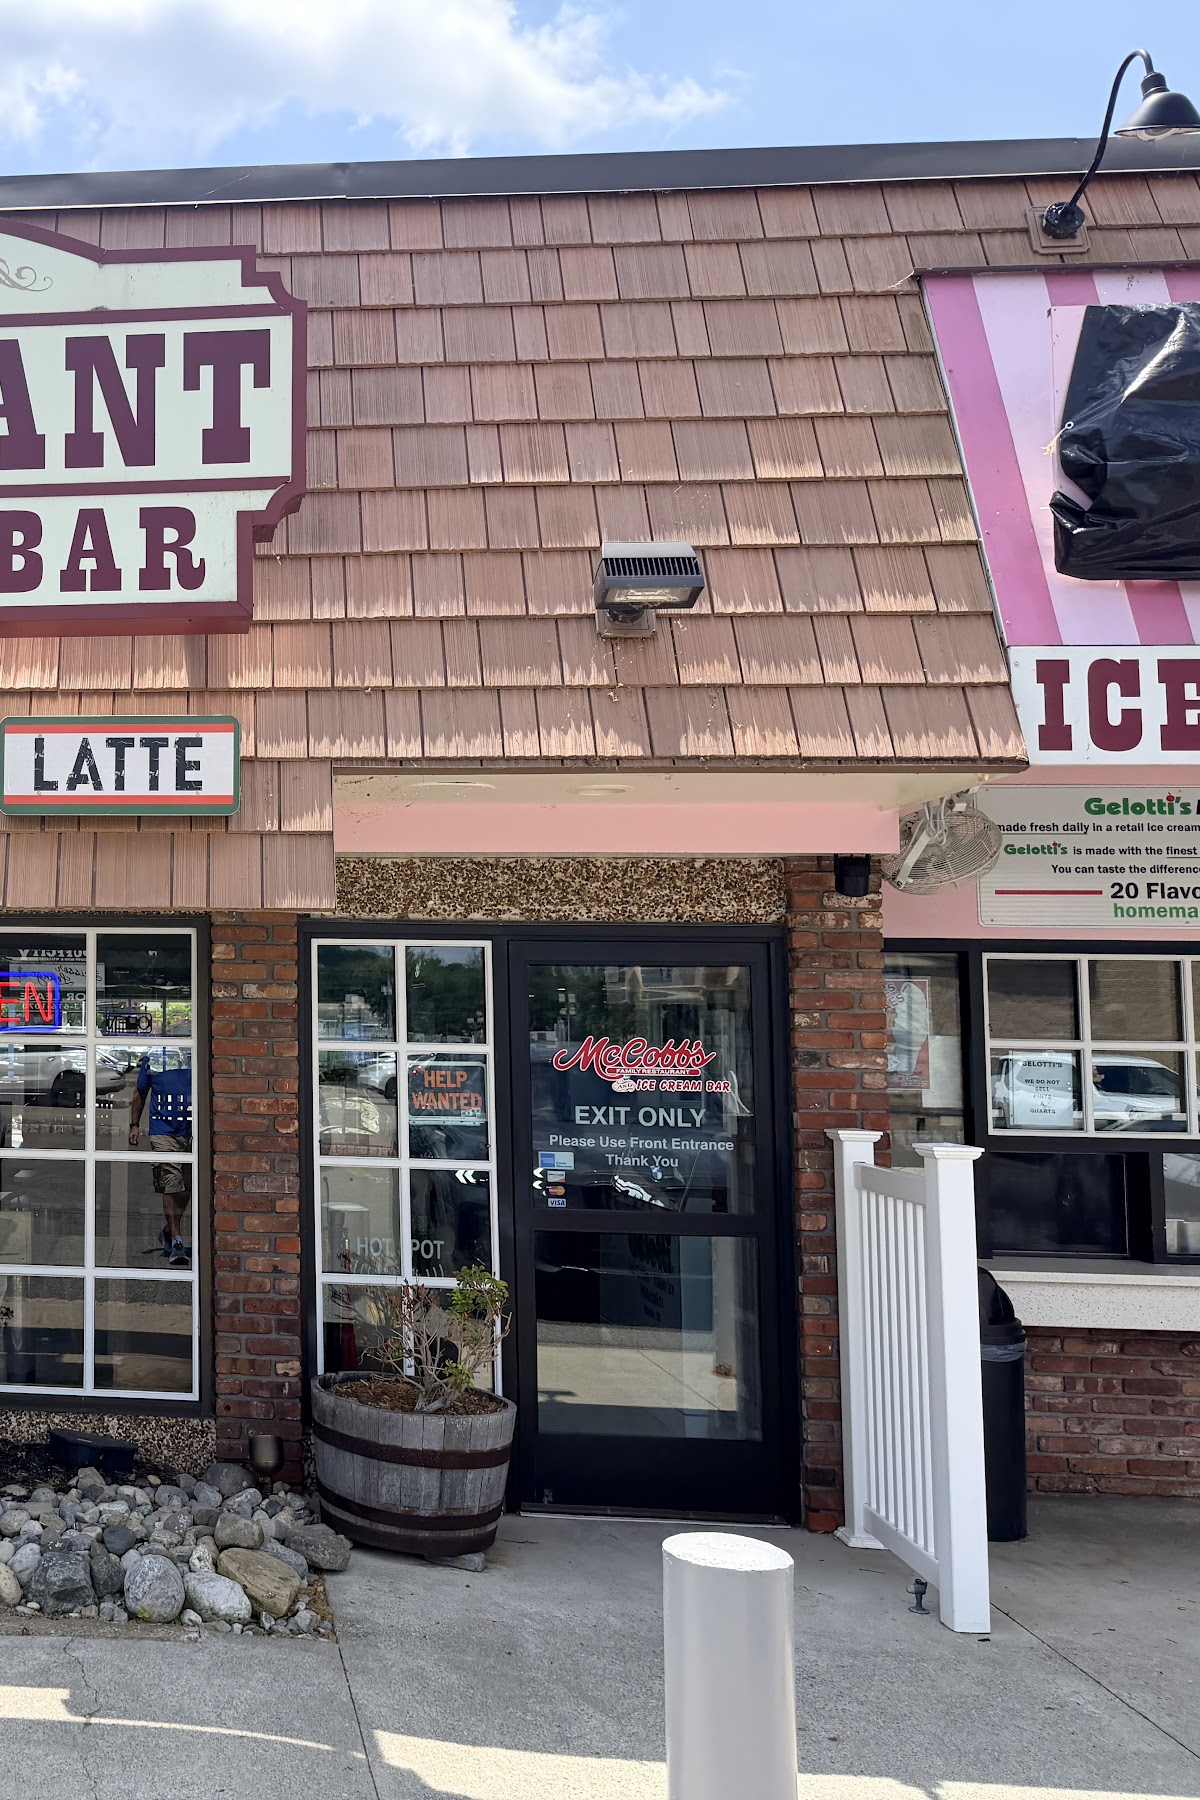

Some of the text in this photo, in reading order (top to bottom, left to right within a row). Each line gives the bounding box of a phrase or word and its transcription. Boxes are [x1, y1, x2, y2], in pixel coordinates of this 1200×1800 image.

[1036, 658, 1200, 752] ICE
[33, 737, 203, 791] LATTE
[1084, 793, 1192, 815] Gelotti's
[1030, 822, 1059, 832] fresh
[1062, 822, 1089, 834] daily
[1092, 822, 1103, 832] in
[1106, 824, 1113, 832] a
[1116, 822, 1144, 832] retail
[1003, 842, 1198, 855] Gelotti's is made with the finest
[1051, 864, 1200, 874] You can taste the differenc
[1110, 882, 1200, 899] 20 Flavo
[1113, 902, 1199, 918] homema
[553, 1036, 716, 1081] McCobb's
[424, 1070, 468, 1088] HELP
[635, 1080, 656, 1091] ICE
[660, 1080, 702, 1092] CREAM
[705, 1080, 731, 1092] BAR
[412, 1092, 482, 1110] WANTED
[575, 1105, 706, 1128] EXIT ONLY
[549, 1134, 734, 1151] Please Use Front Entrance
[605, 1154, 679, 1168] Thank You
[356, 1237, 393, 1257] HOT
